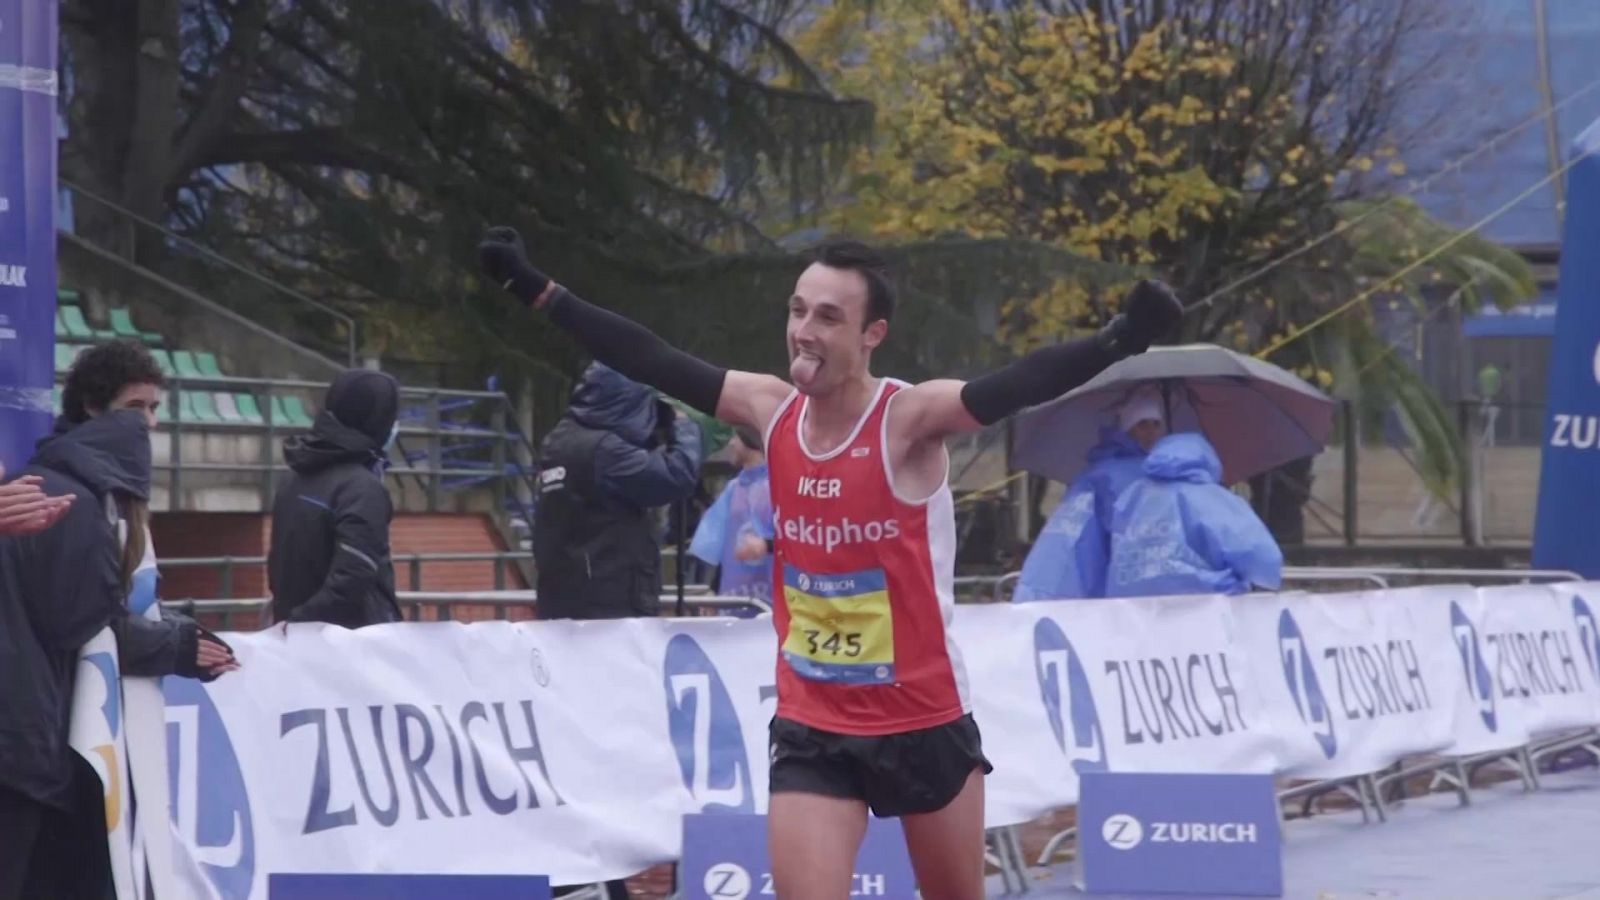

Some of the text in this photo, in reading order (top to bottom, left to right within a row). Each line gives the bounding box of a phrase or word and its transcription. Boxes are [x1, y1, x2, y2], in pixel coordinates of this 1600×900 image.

[1551, 414, 1600, 450] ZU
[797, 476, 841, 498] IKER
[804, 630, 862, 657] 345
[1487, 630, 1583, 697] ZURICH
[1105, 653, 1248, 745] ZURICH
[1325, 639, 1431, 719] ZURICH
[280, 700, 567, 834] ZURICH
[1151, 822, 1257, 842] ZURICH
